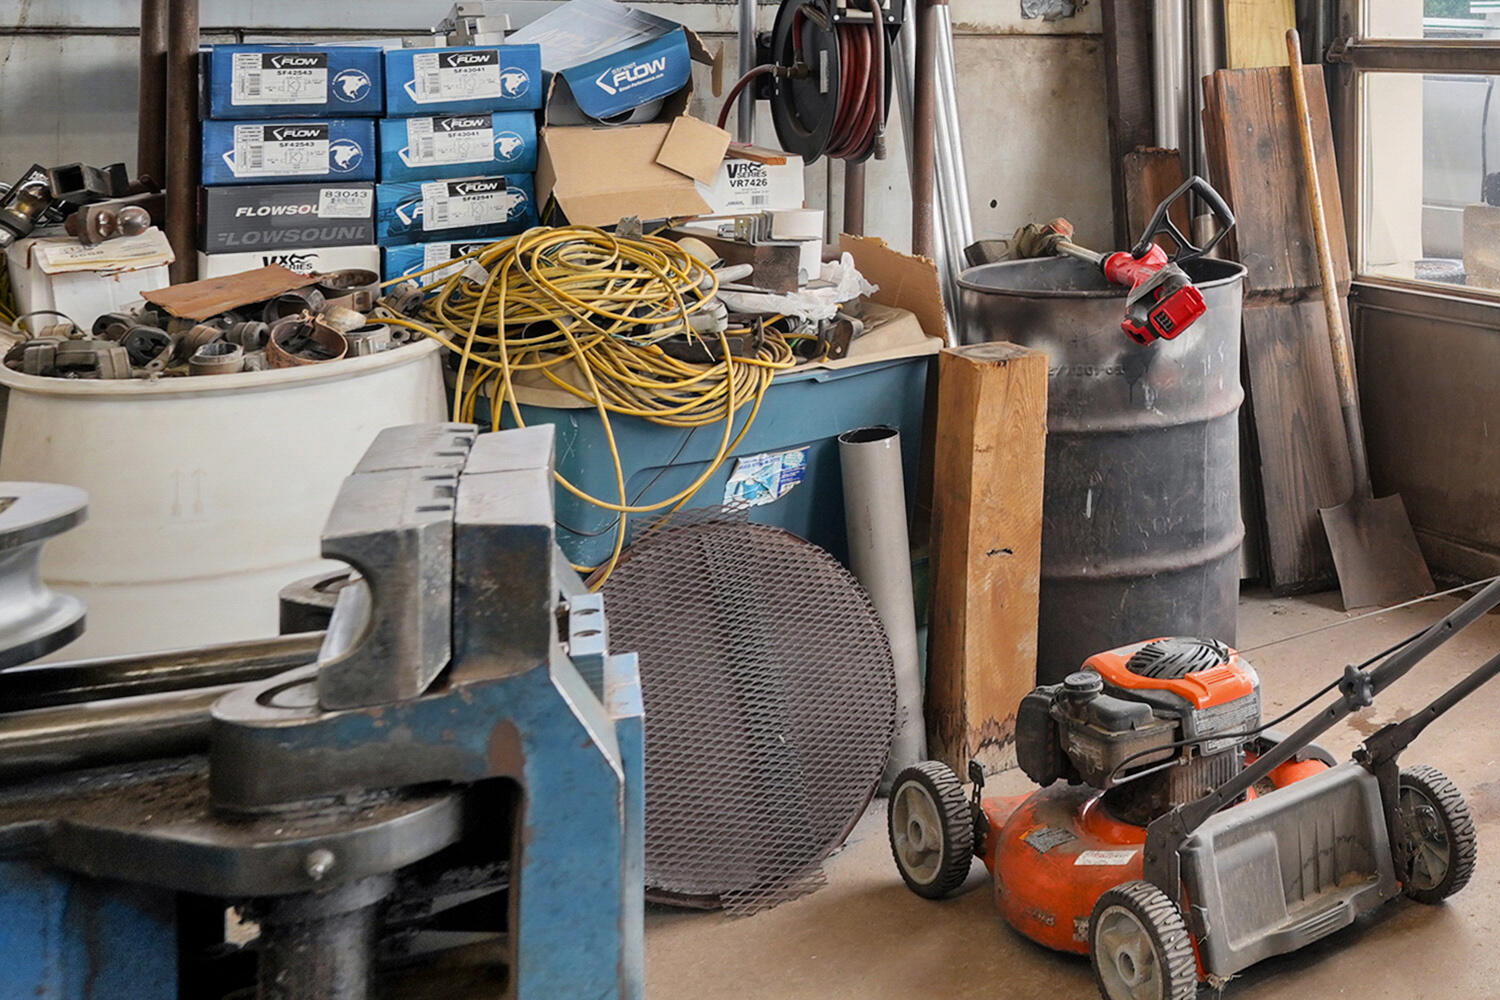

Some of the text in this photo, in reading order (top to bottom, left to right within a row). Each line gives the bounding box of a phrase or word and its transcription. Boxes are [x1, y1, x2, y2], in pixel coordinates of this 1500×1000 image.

[281, 58, 318, 67] FLOW
[457, 55, 490, 64] FLOW
[612, 56, 666, 87] FLOW
[450, 119, 484, 128] FLOW
[283, 129, 321, 138] FLOW
[465, 182, 498, 192] FLOW
[729, 179, 768, 187] VR7426
[324, 190, 368, 198] 83043
[235, 204, 320, 218] FLOWSOU
